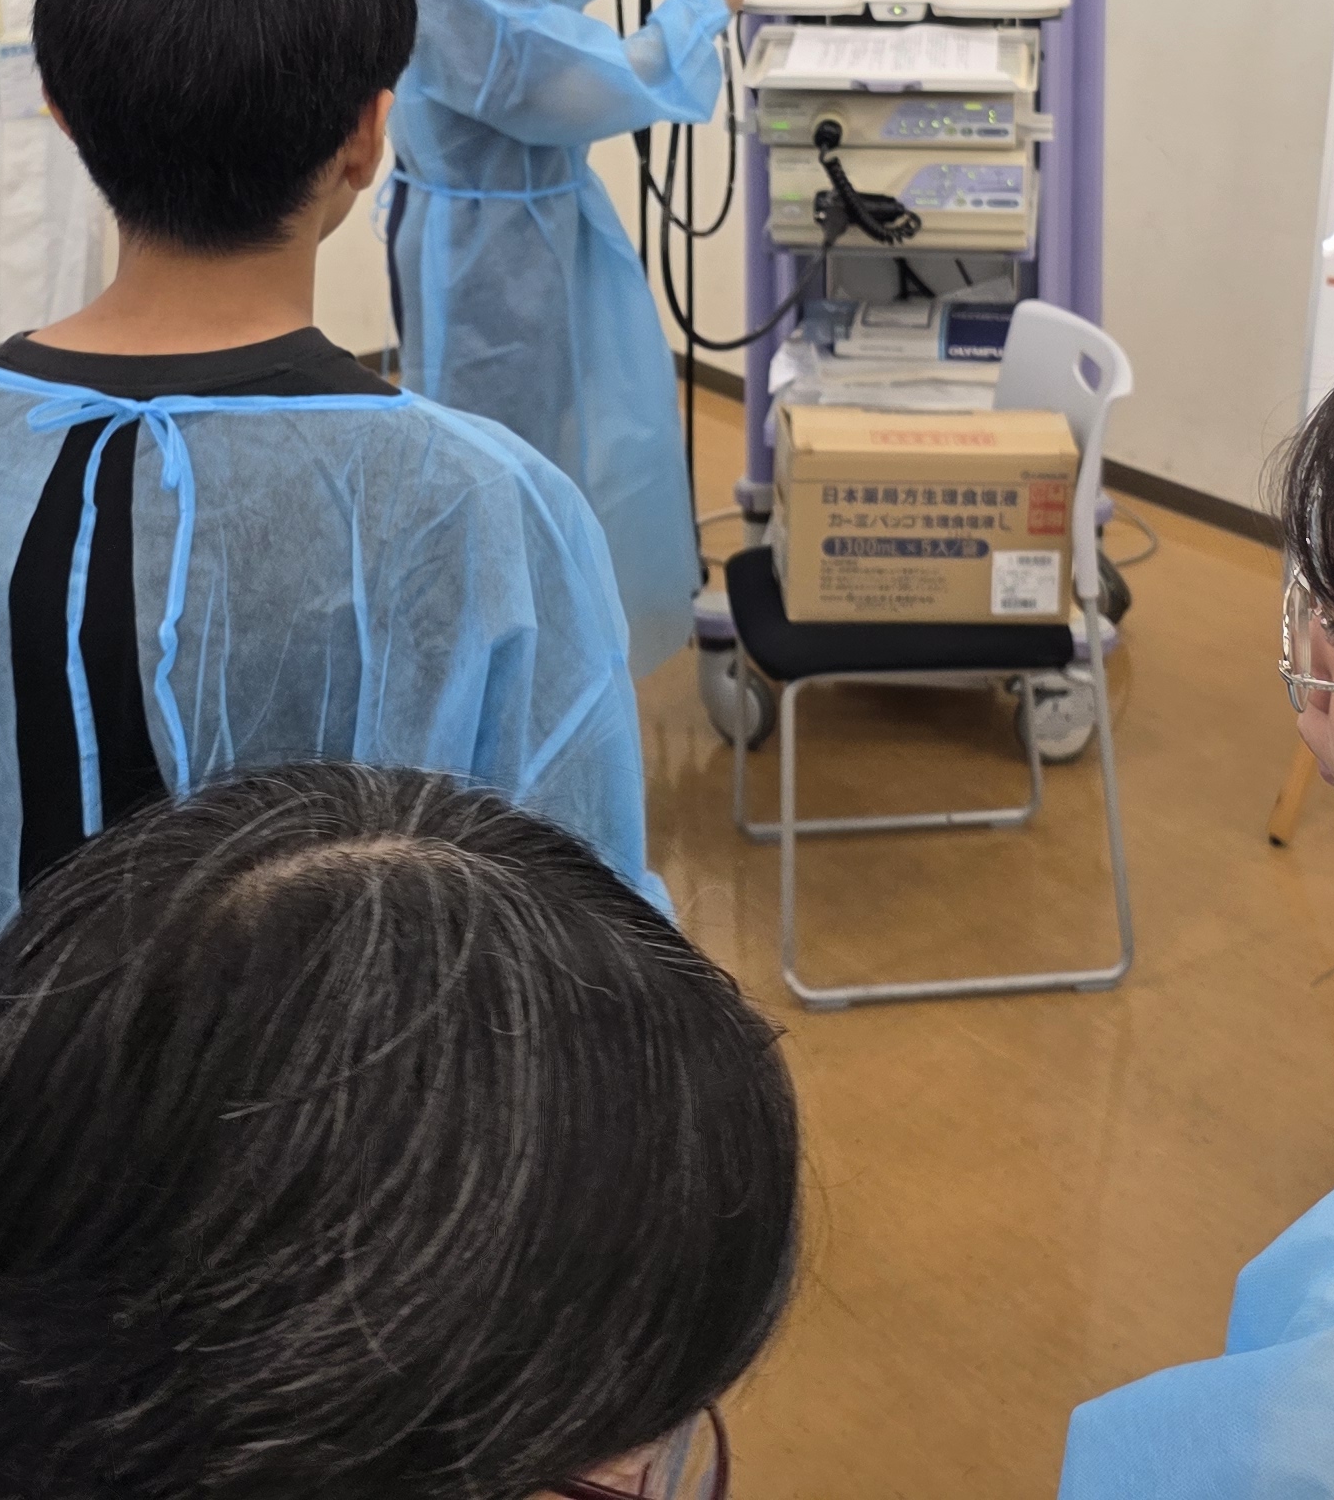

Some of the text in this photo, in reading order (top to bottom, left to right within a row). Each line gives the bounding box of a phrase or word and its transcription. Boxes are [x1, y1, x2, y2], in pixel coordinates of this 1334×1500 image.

[948, 345, 1005, 357] OLYMPU
[822, 484, 1018, 507] 日本薬局方生理食塩液
